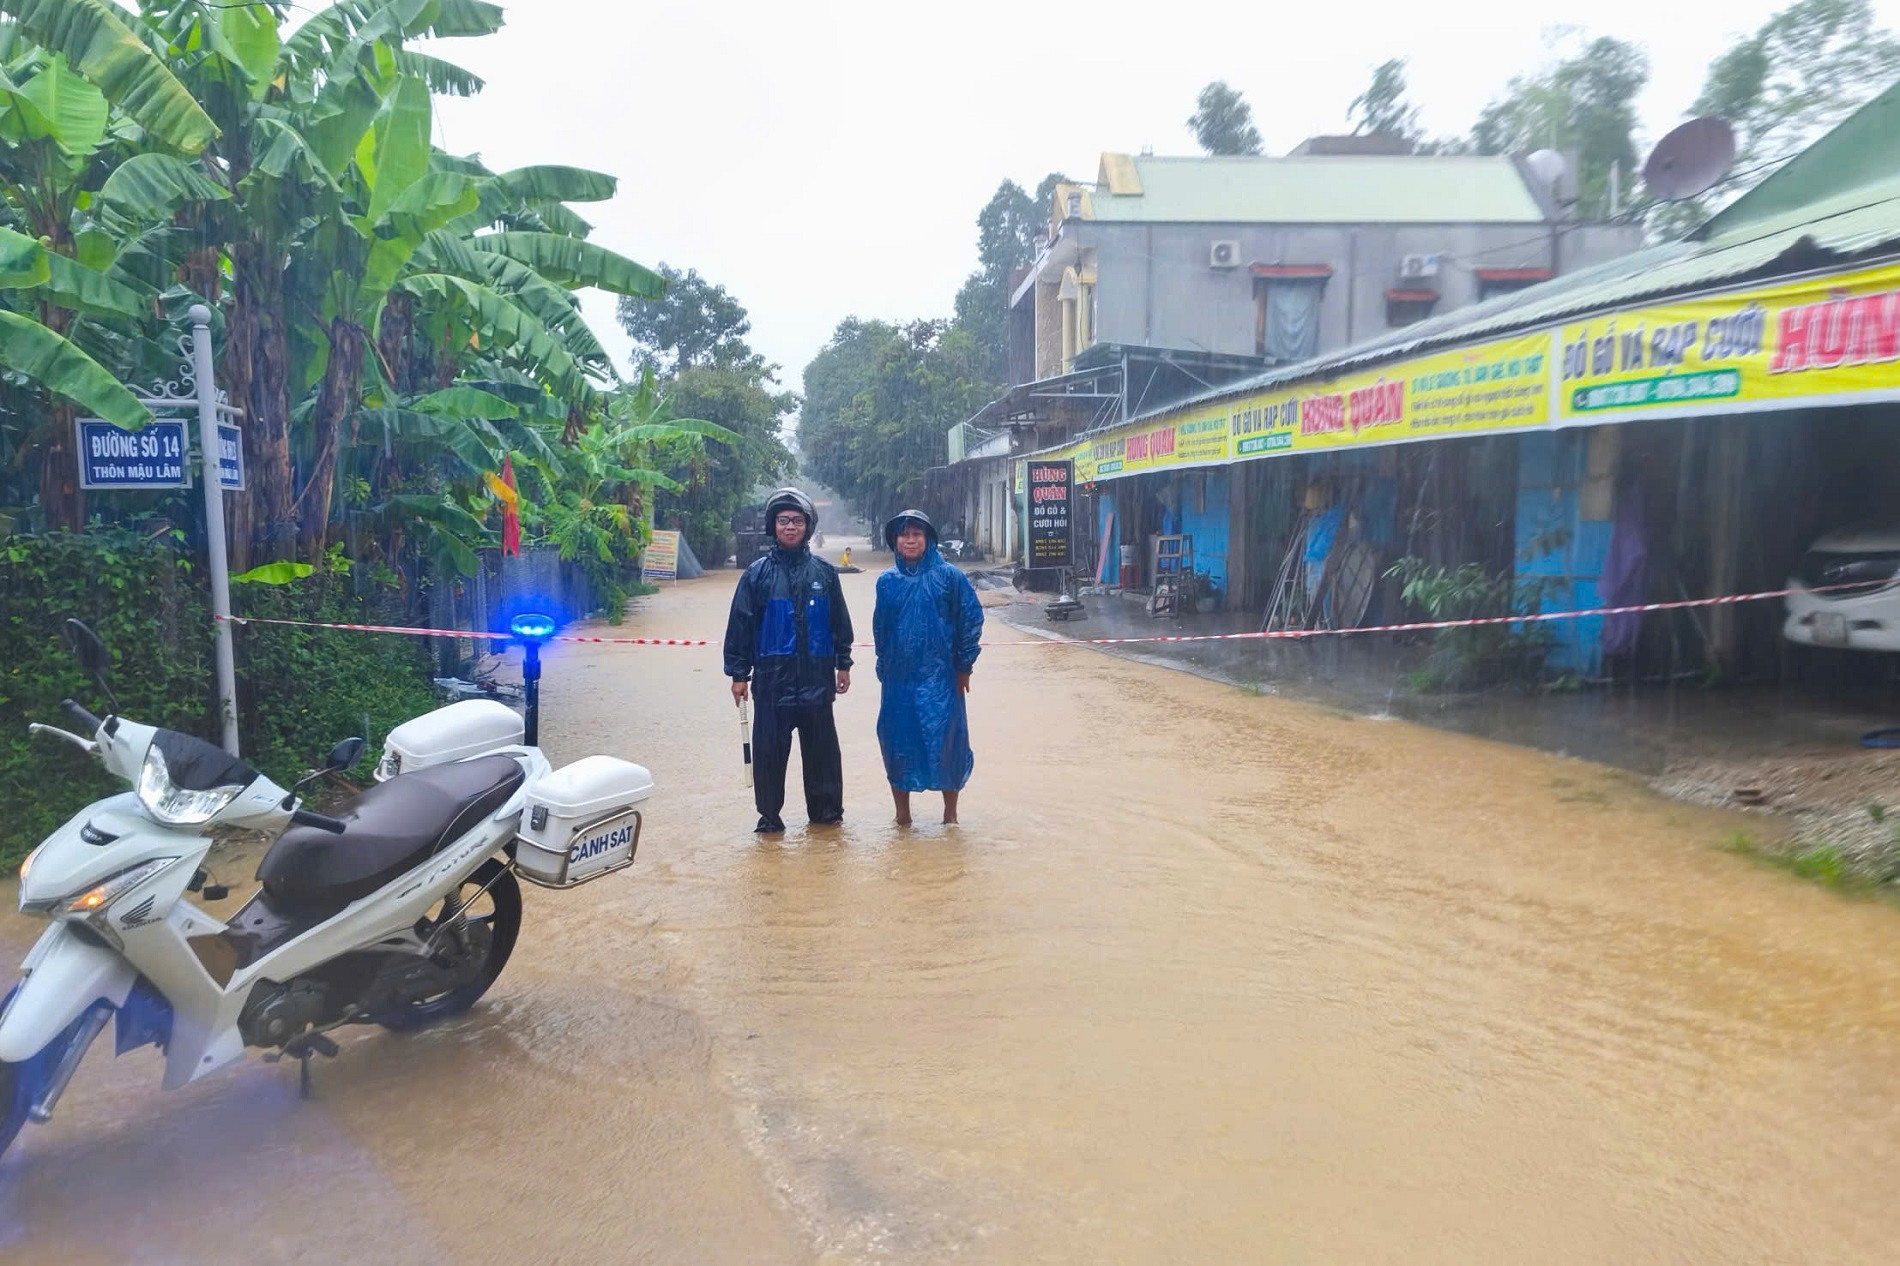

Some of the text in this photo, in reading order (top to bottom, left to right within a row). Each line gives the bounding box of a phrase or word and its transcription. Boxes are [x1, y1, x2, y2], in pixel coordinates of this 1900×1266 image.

[92, 428, 180, 458] ĐƯỜNG SỐ 14
[93, 463, 181, 480] THÔN MẬU LÂM
[1032, 466, 1067, 482] HÙNG
[1033, 484, 1067, 504] QUÂN
[1060, 506, 1066, 515] &
[1054, 517, 1067, 528] HỎI
